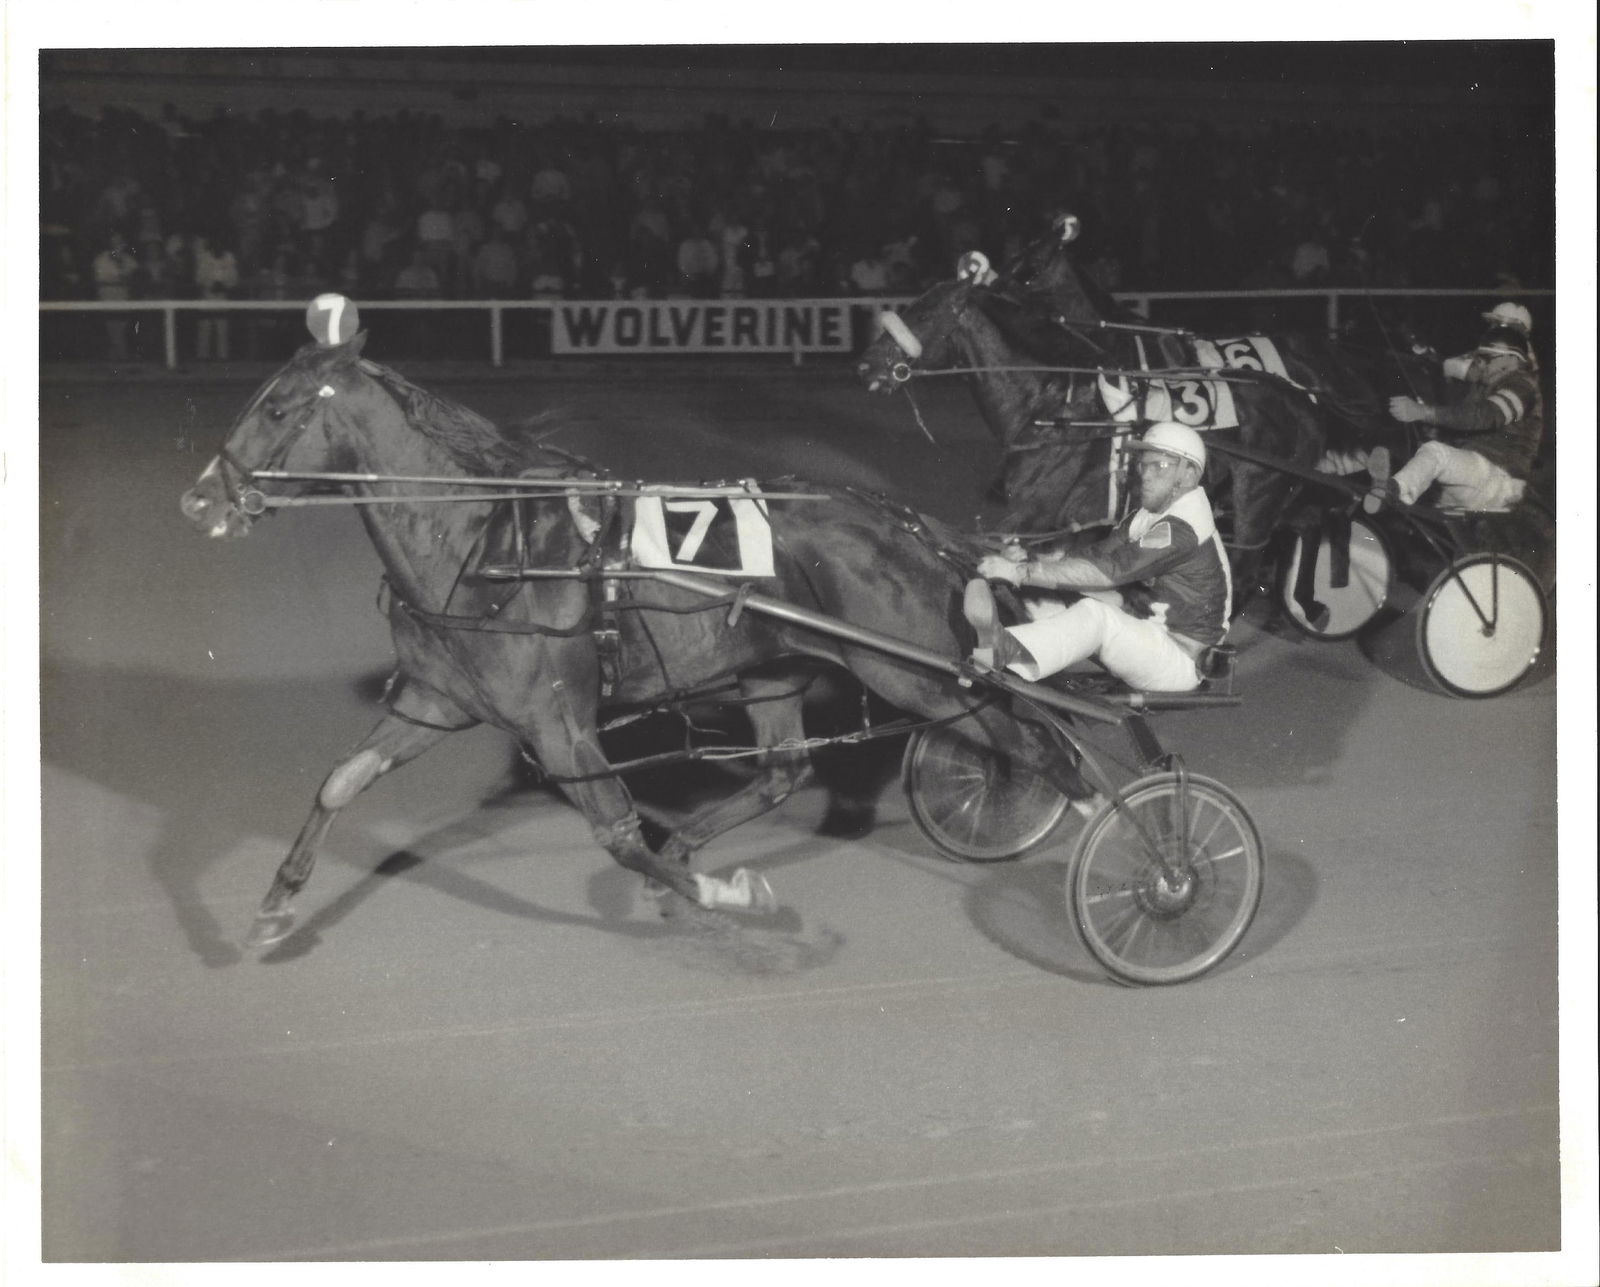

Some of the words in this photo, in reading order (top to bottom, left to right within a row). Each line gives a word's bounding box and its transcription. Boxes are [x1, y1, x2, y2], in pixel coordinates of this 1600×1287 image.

[316, 293, 346, 346] 7
[561, 306, 843, 347] WOLVERINE
[1168, 381, 1210, 426] 3
[665, 500, 719, 562] 7
